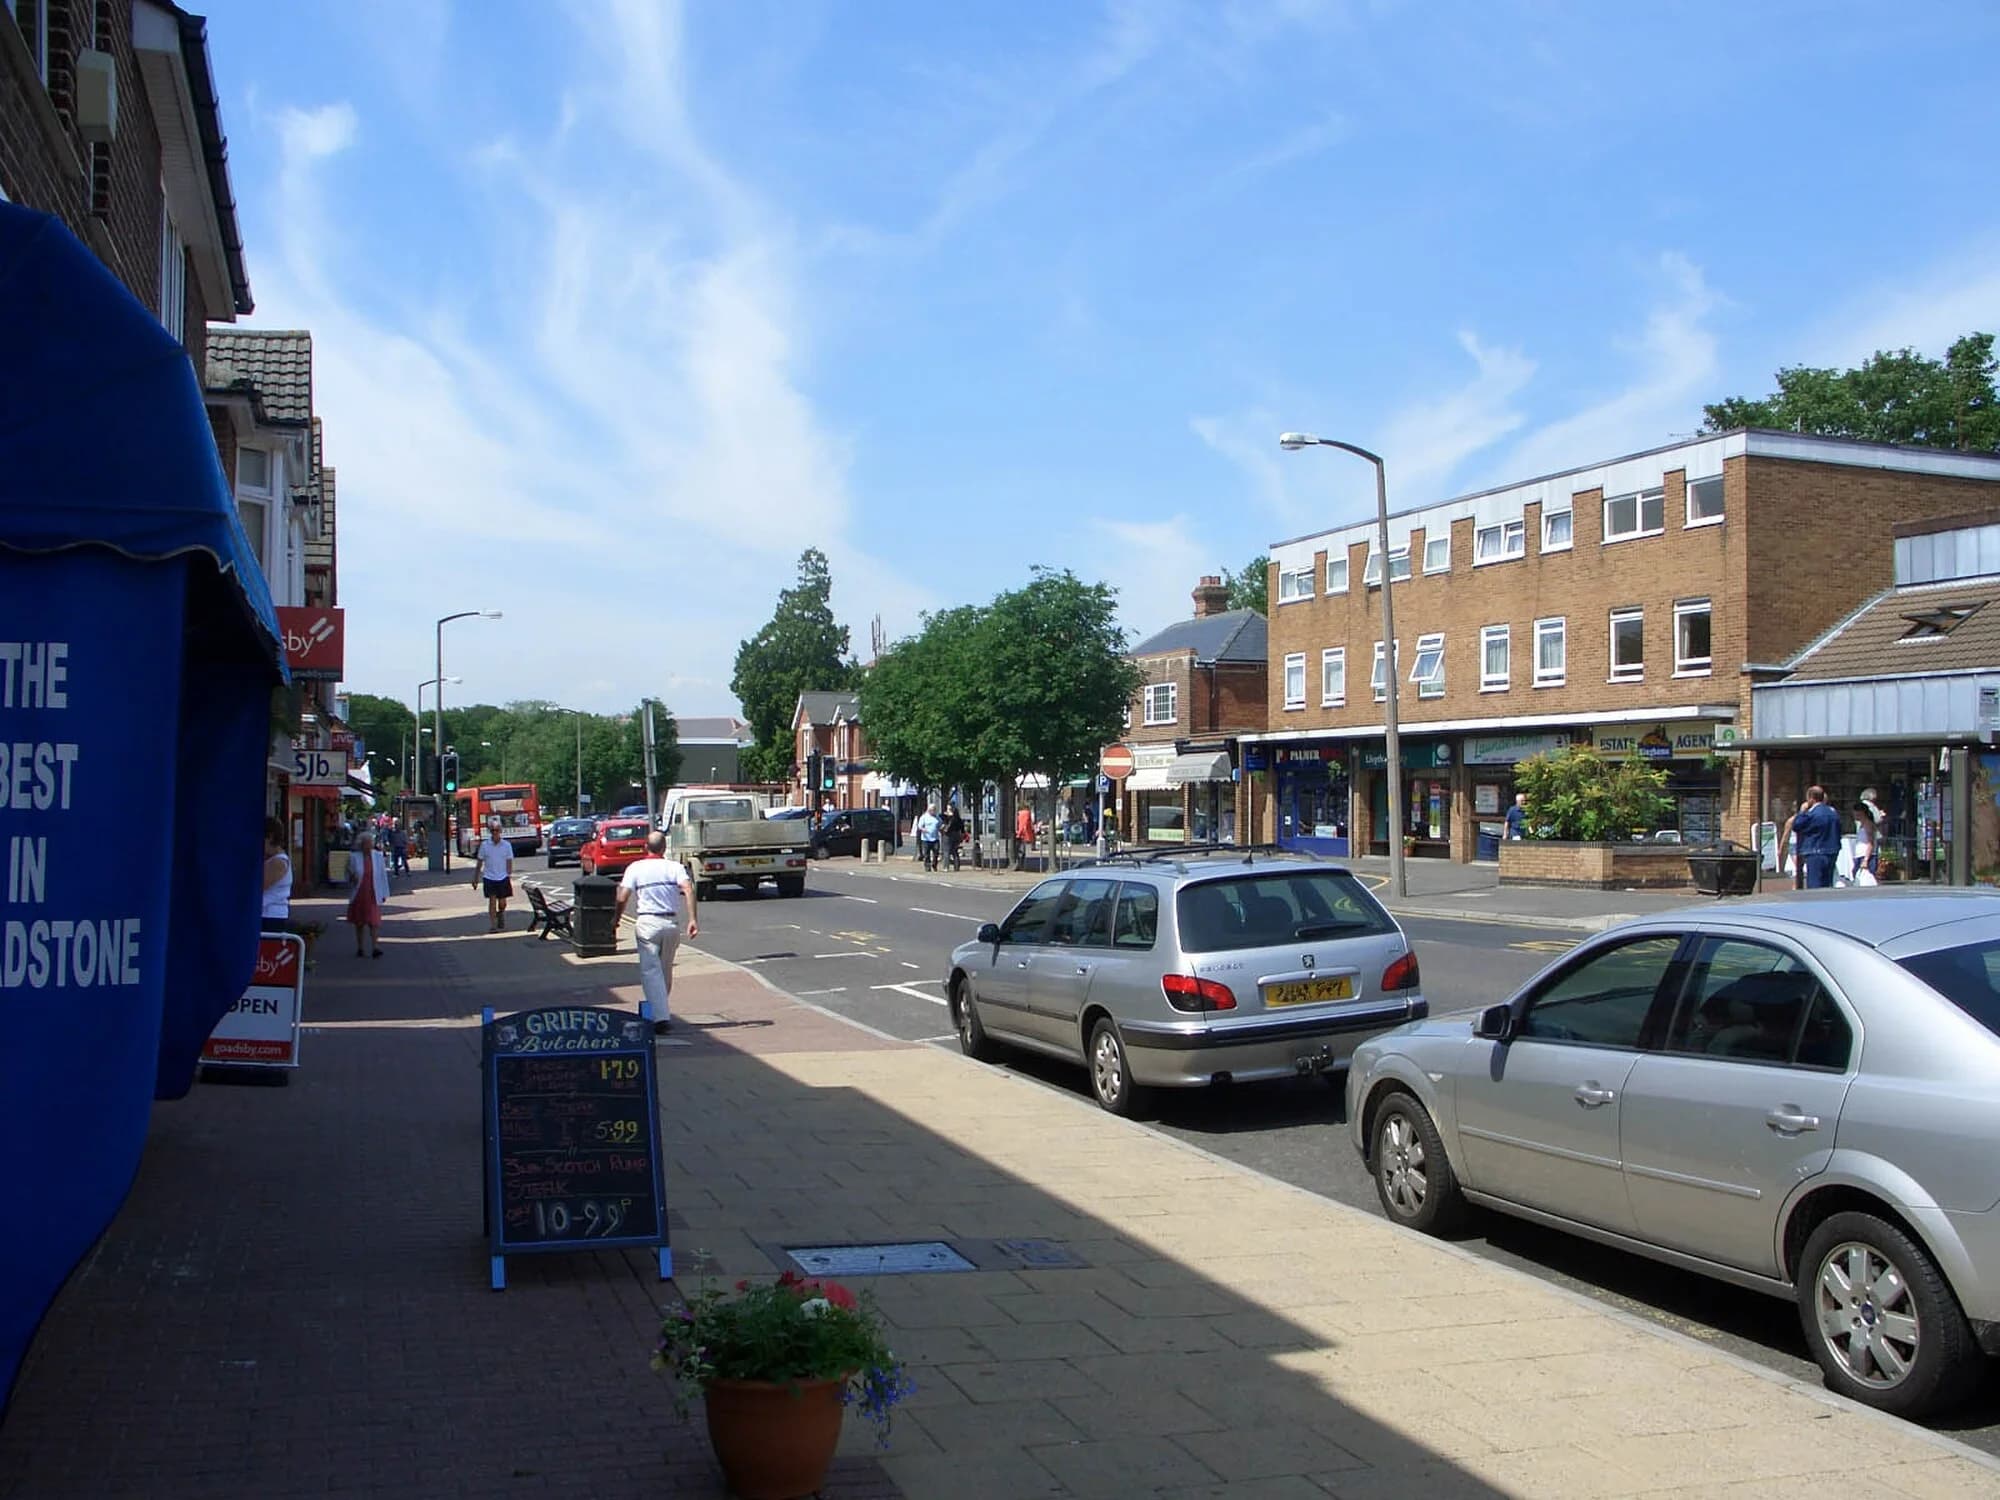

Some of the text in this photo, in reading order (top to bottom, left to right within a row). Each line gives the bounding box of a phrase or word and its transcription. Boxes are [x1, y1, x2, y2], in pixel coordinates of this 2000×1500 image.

[0, 642, 68, 709] THE
[333, 734, 353, 743] JVC
[8, 836, 47, 904] IN
[0, 918, 141, 989] DSTONE
[526, 1010, 610, 1035] GRIFFS
[212, 1042, 283, 1057] goadsby.com
